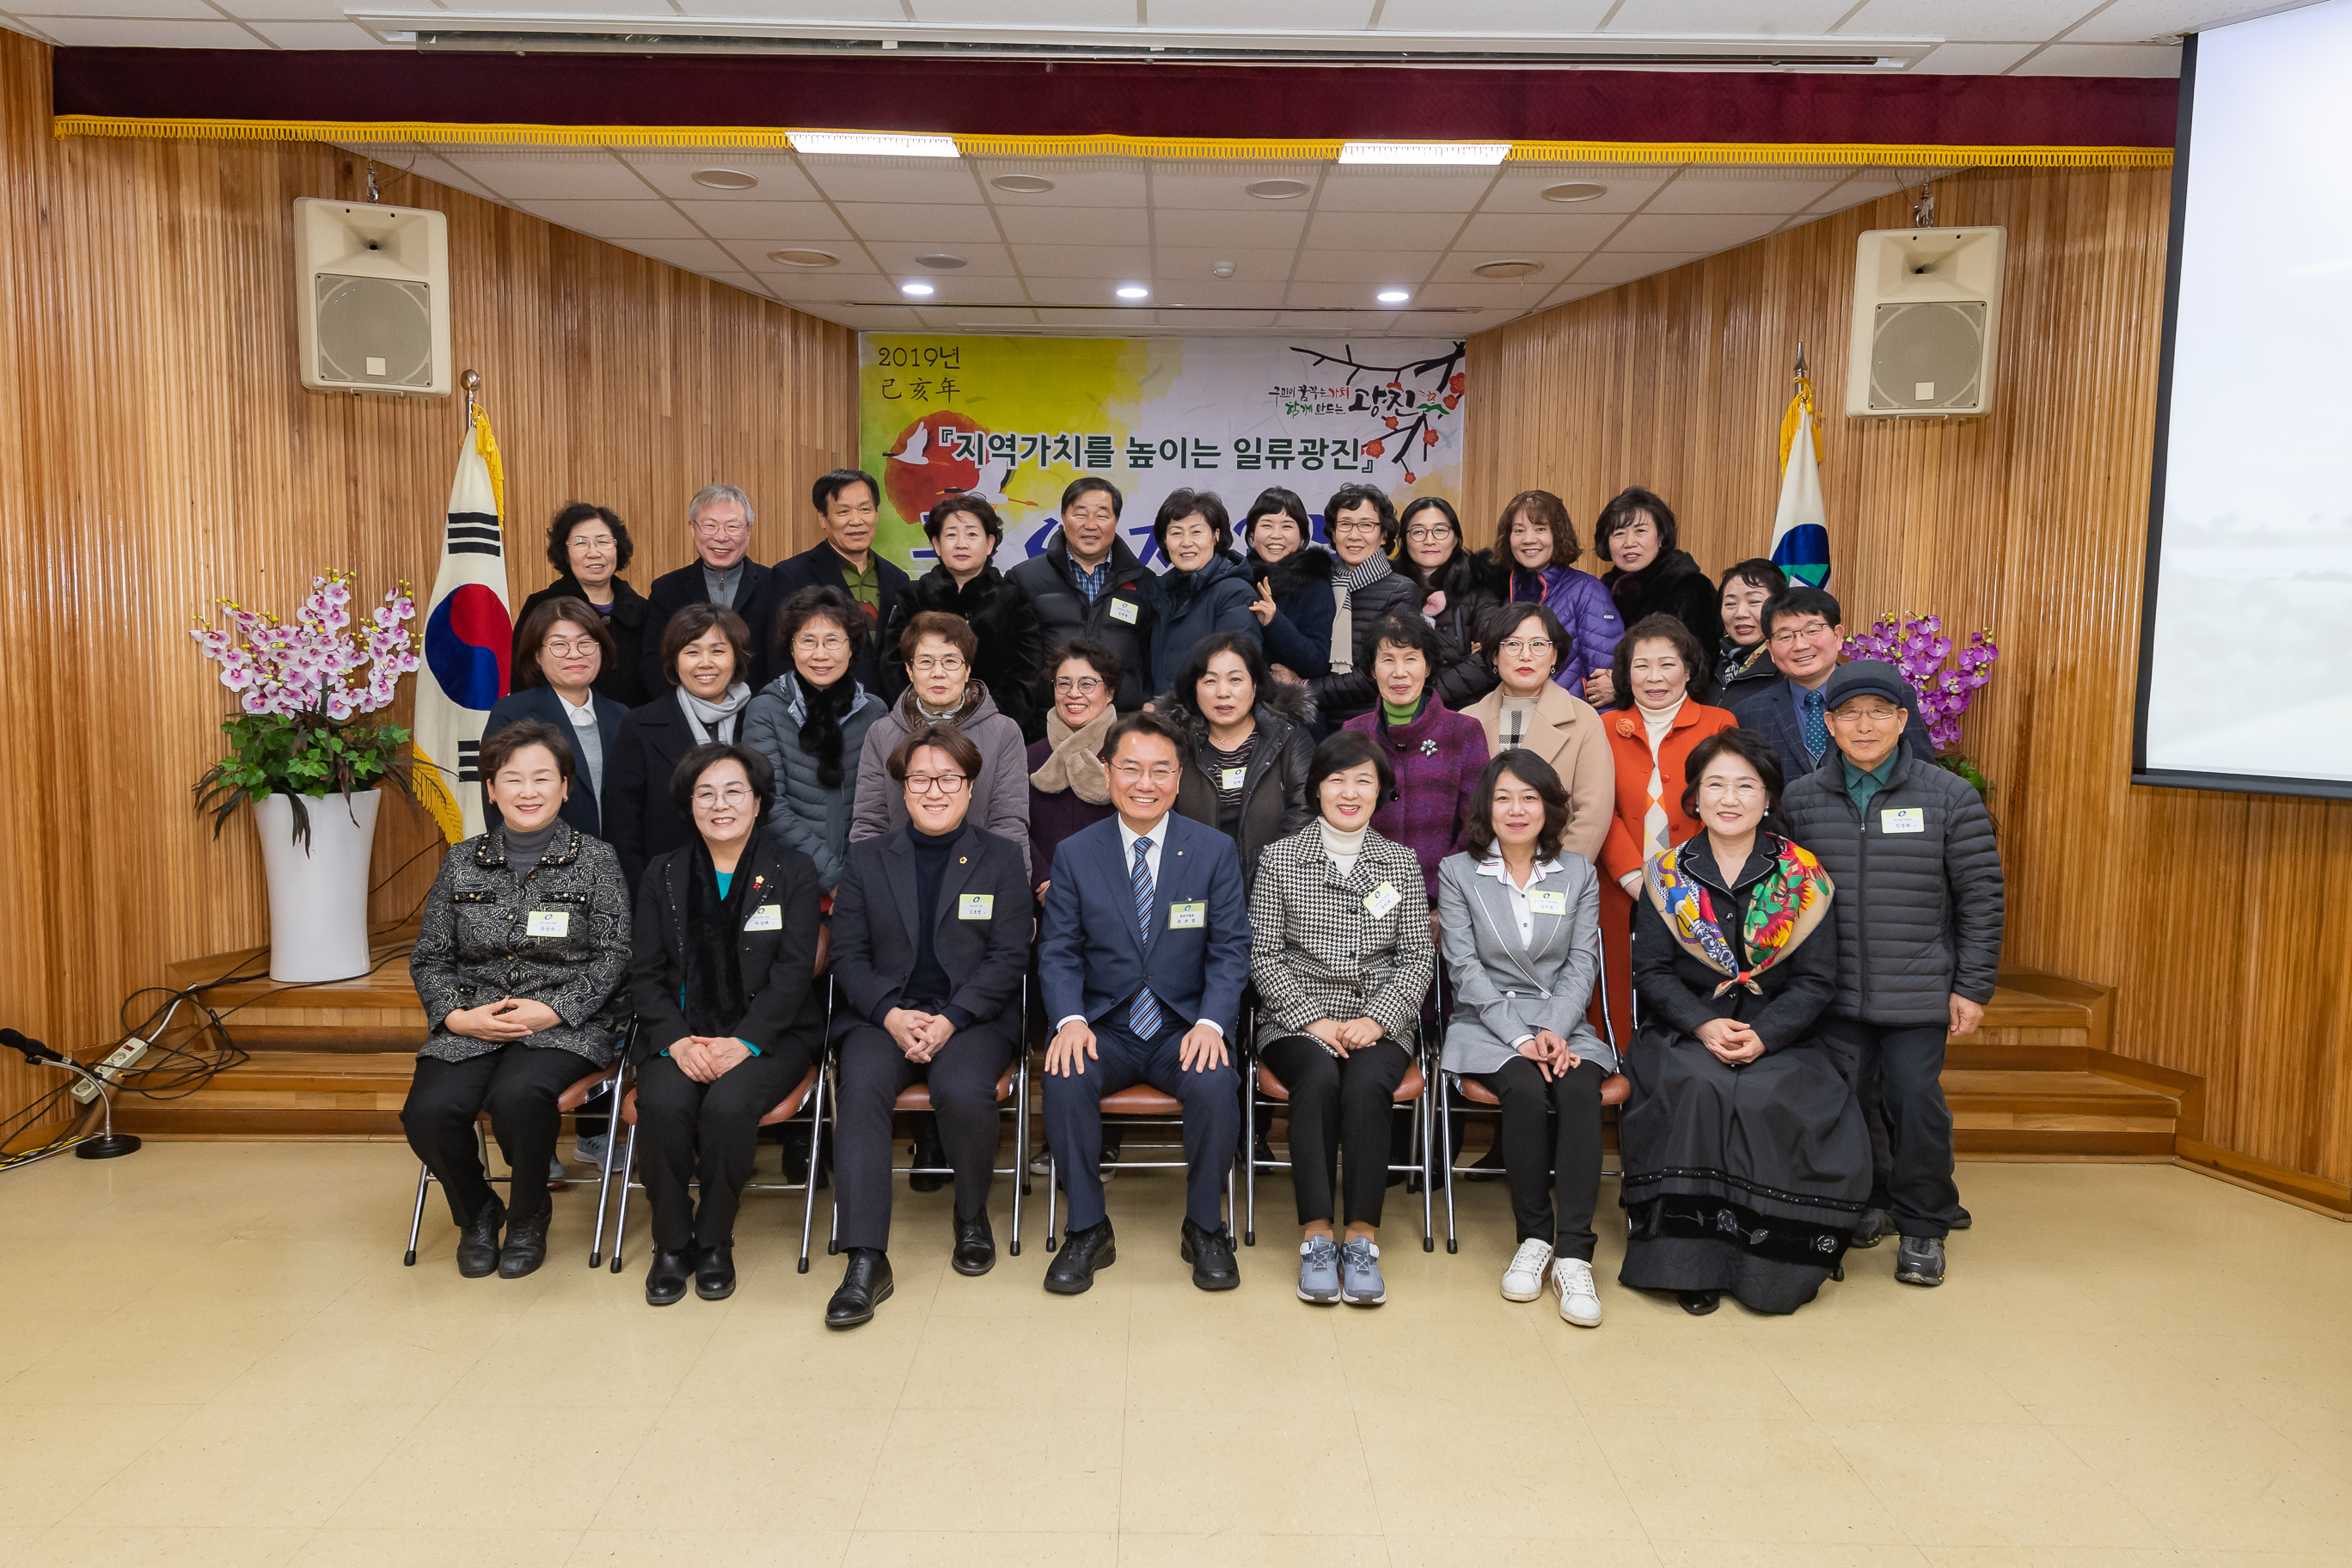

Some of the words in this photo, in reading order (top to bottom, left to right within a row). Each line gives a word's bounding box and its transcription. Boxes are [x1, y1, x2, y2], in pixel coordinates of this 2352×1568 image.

[878, 346, 960, 370] 2019년
[881, 377, 961, 403] 己亥年
[1268, 385, 1295, 407] 구민이
[1296, 383, 1331, 402] 꿈꾸는
[1328, 387, 1350, 400] 가치
[1348, 384, 1419, 418] 광진
[1284, 401, 1313, 419] 함께
[1314, 402, 1346, 416] 만드는
[1125, 436, 1222, 469] 높이는
